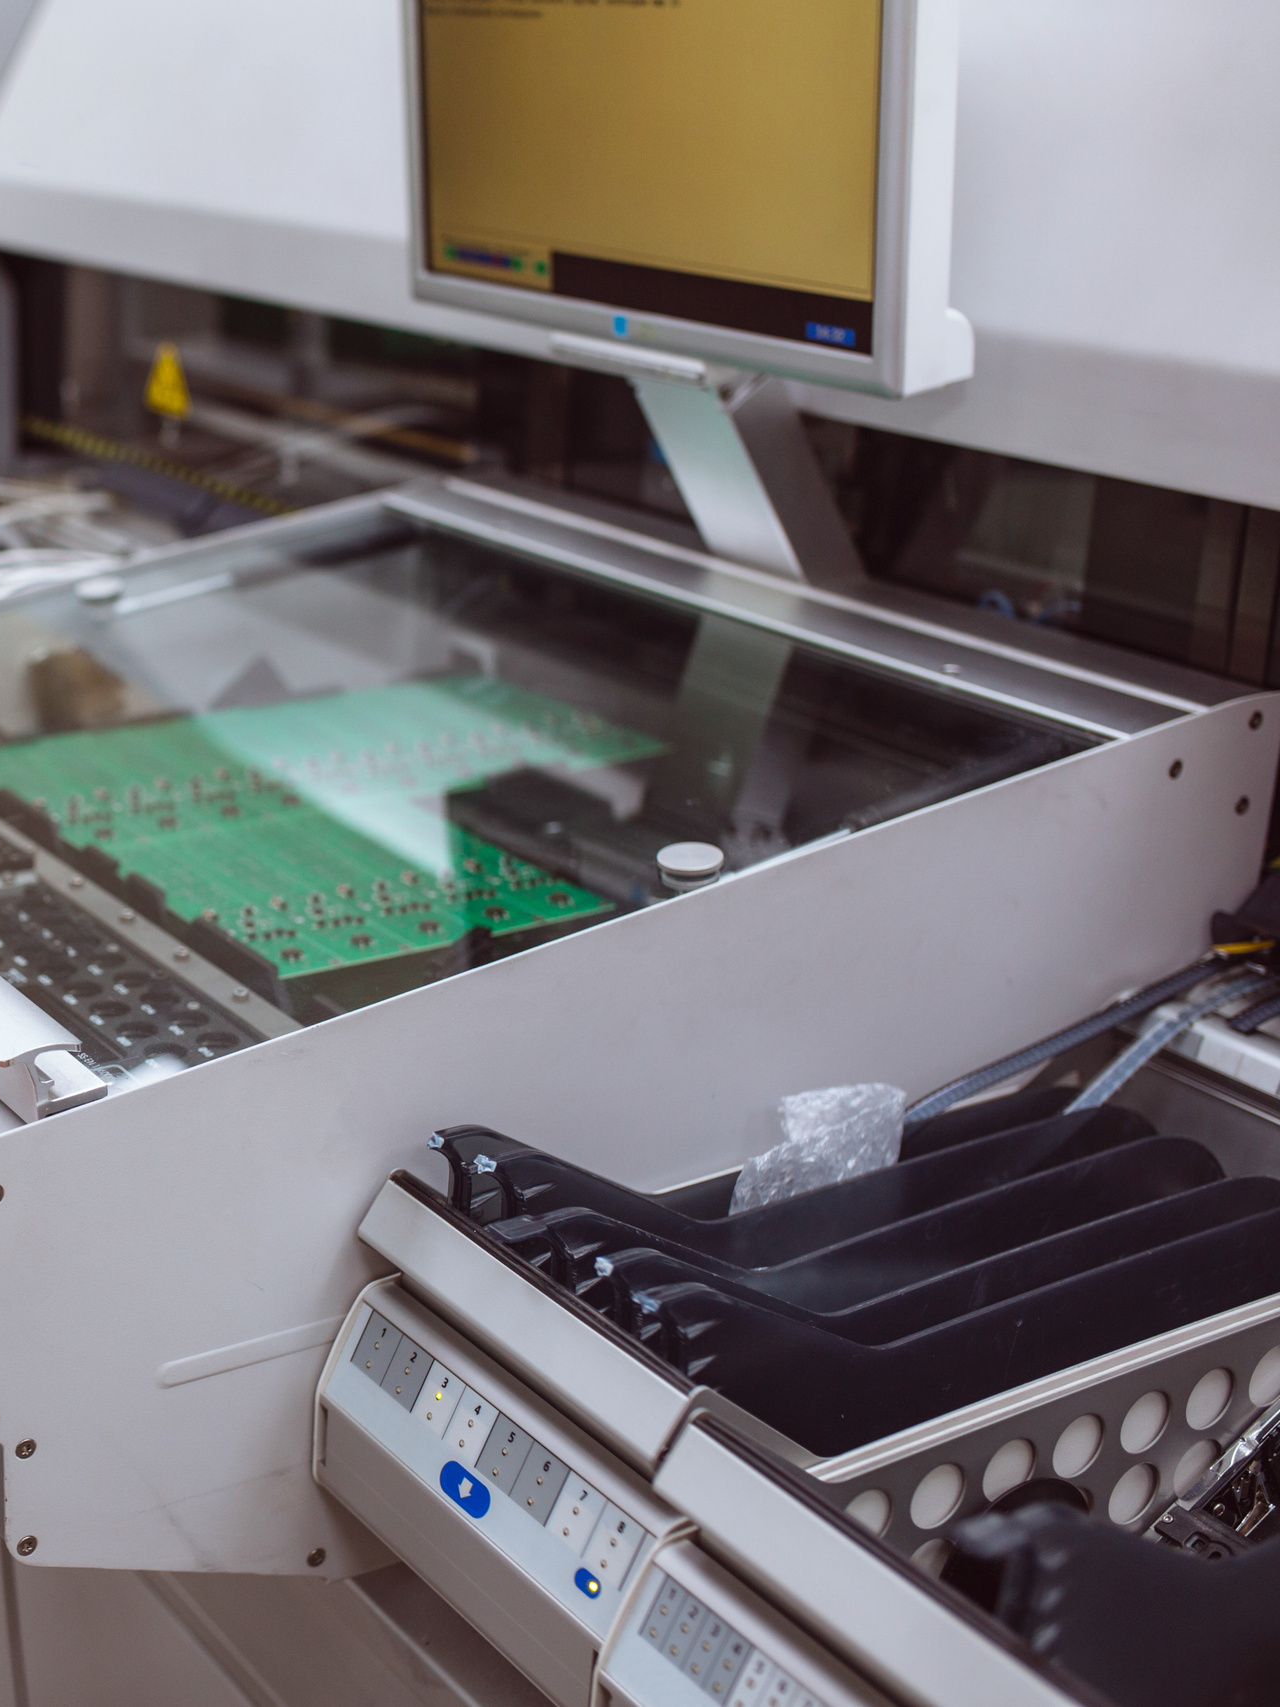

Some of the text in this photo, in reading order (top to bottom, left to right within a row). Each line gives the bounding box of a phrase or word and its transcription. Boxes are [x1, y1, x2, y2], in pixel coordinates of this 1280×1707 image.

[381, 1327, 626, 1534] 1 2 3 4 5 6 7 8
[688, 1605, 699, 1619] 2
